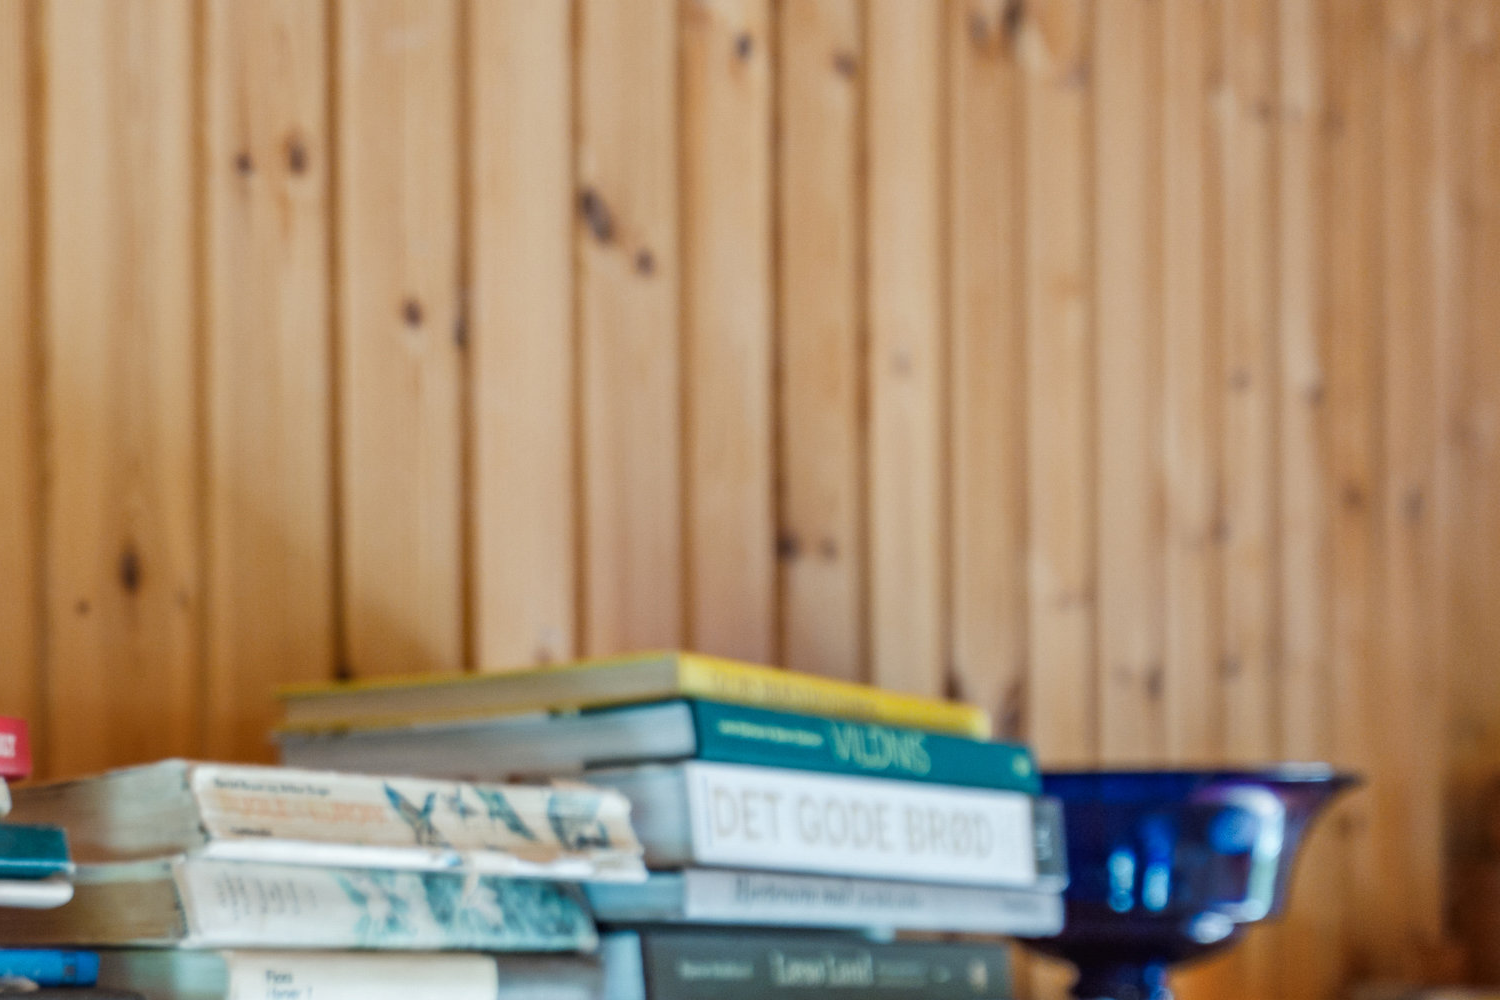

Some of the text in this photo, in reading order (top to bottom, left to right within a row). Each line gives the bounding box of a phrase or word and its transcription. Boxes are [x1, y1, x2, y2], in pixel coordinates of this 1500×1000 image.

[712, 785, 994, 860] DET GODE BRØD
